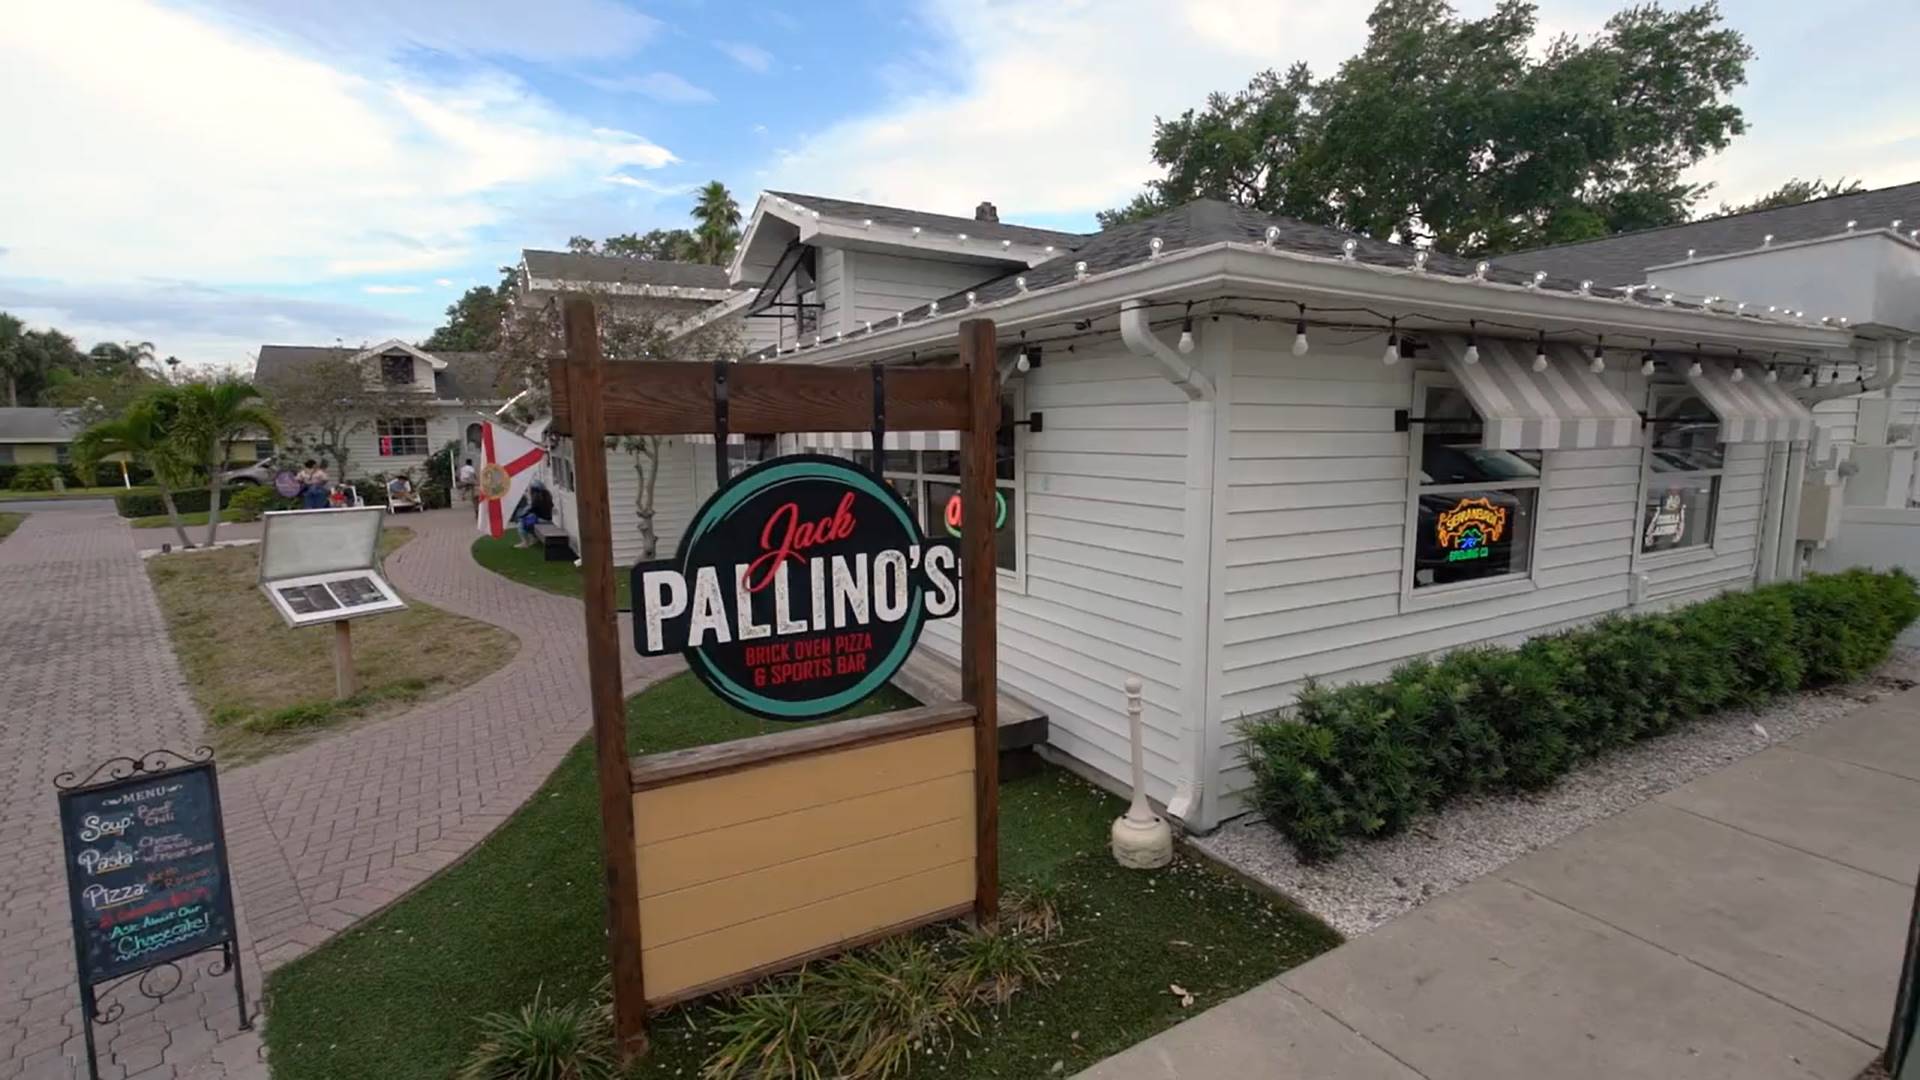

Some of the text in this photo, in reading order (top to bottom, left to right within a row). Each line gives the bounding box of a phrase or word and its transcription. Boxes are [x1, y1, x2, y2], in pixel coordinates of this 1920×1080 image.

[743, 491, 857, 593] Jack
[642, 544, 957, 652] PALLINO'S
[746, 632, 873, 667] BRICK OVEN PIZZA
[754, 653, 867, 688] & SPORTS BAR
[123, 786, 166, 804] MENU
[80, 813, 135, 842] Soup:
[178, 905, 203, 918] Our
